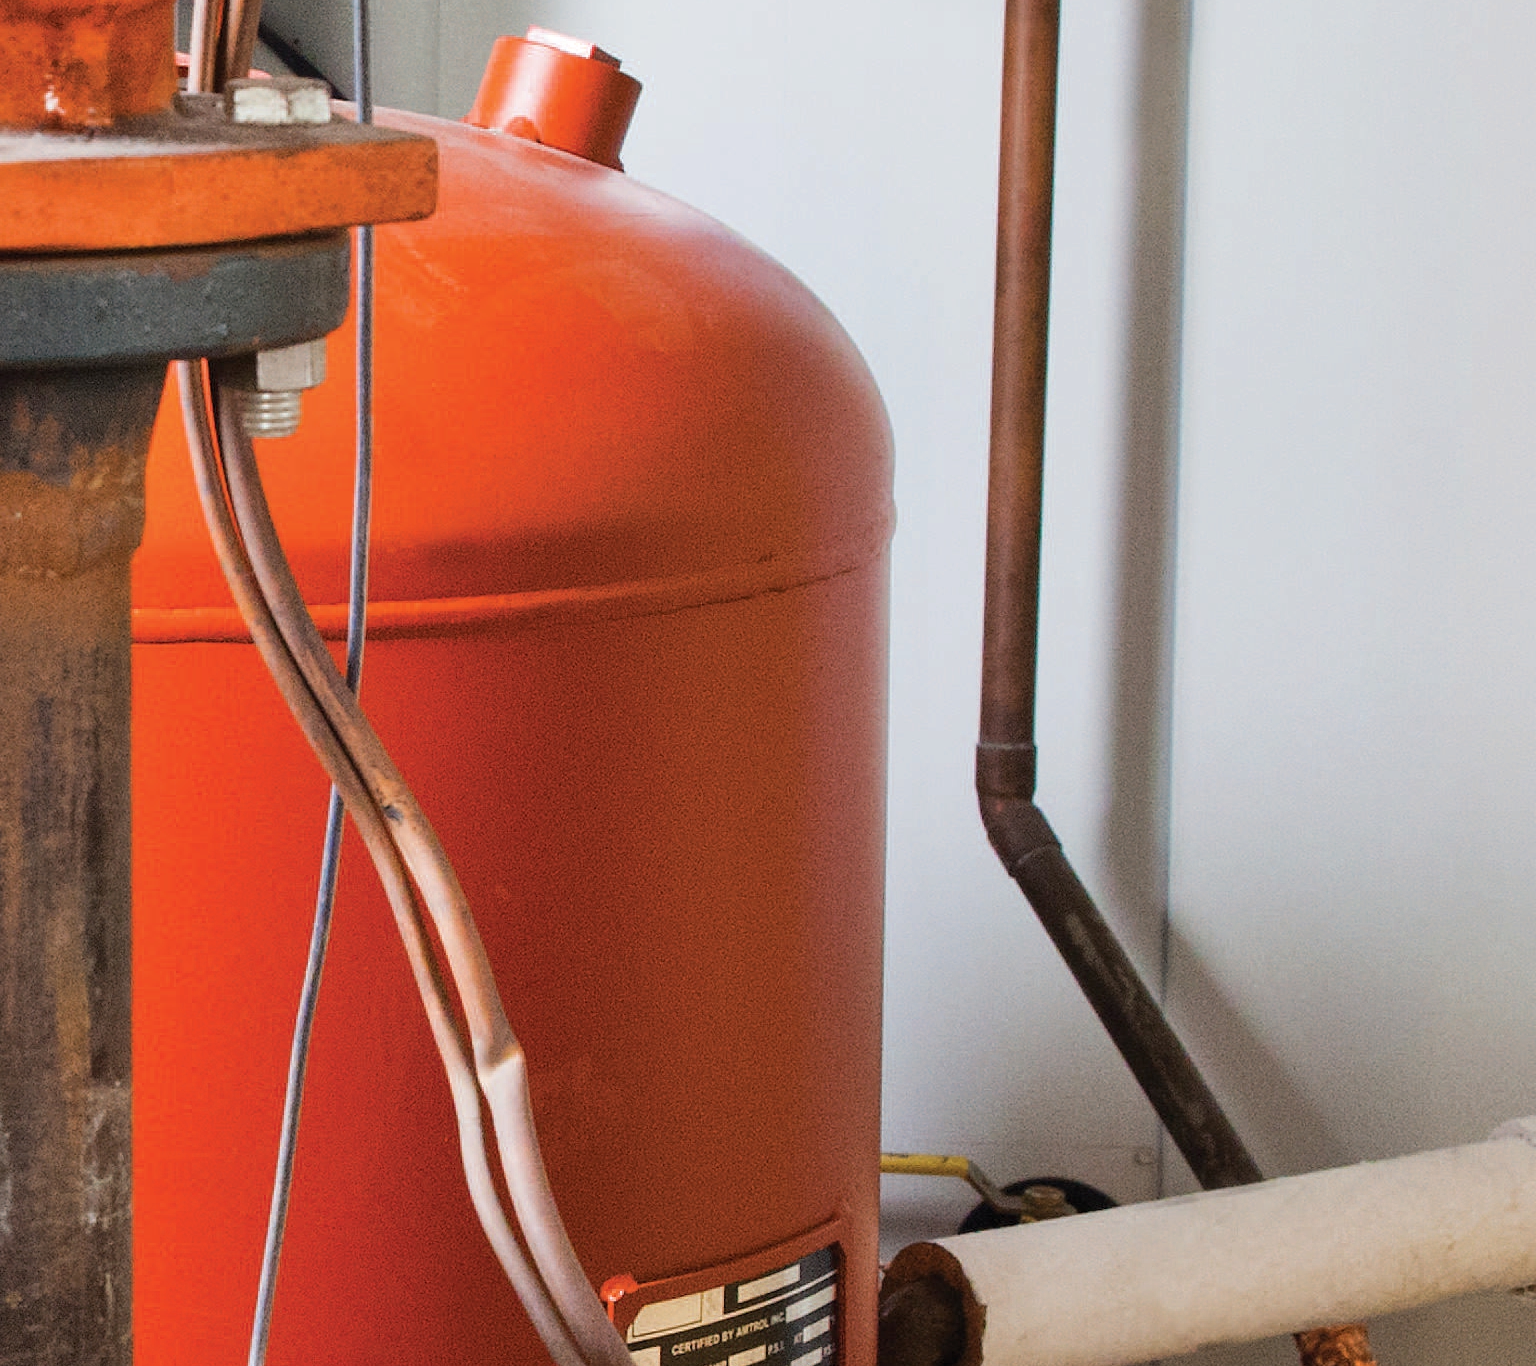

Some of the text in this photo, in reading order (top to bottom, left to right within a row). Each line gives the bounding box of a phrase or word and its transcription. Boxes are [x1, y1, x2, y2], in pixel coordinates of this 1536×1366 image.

[671, 1334, 720, 1356] CERTIFIED
[721, 1328, 735, 1343] BY
[736, 1317, 770, 1338] AMTROL
